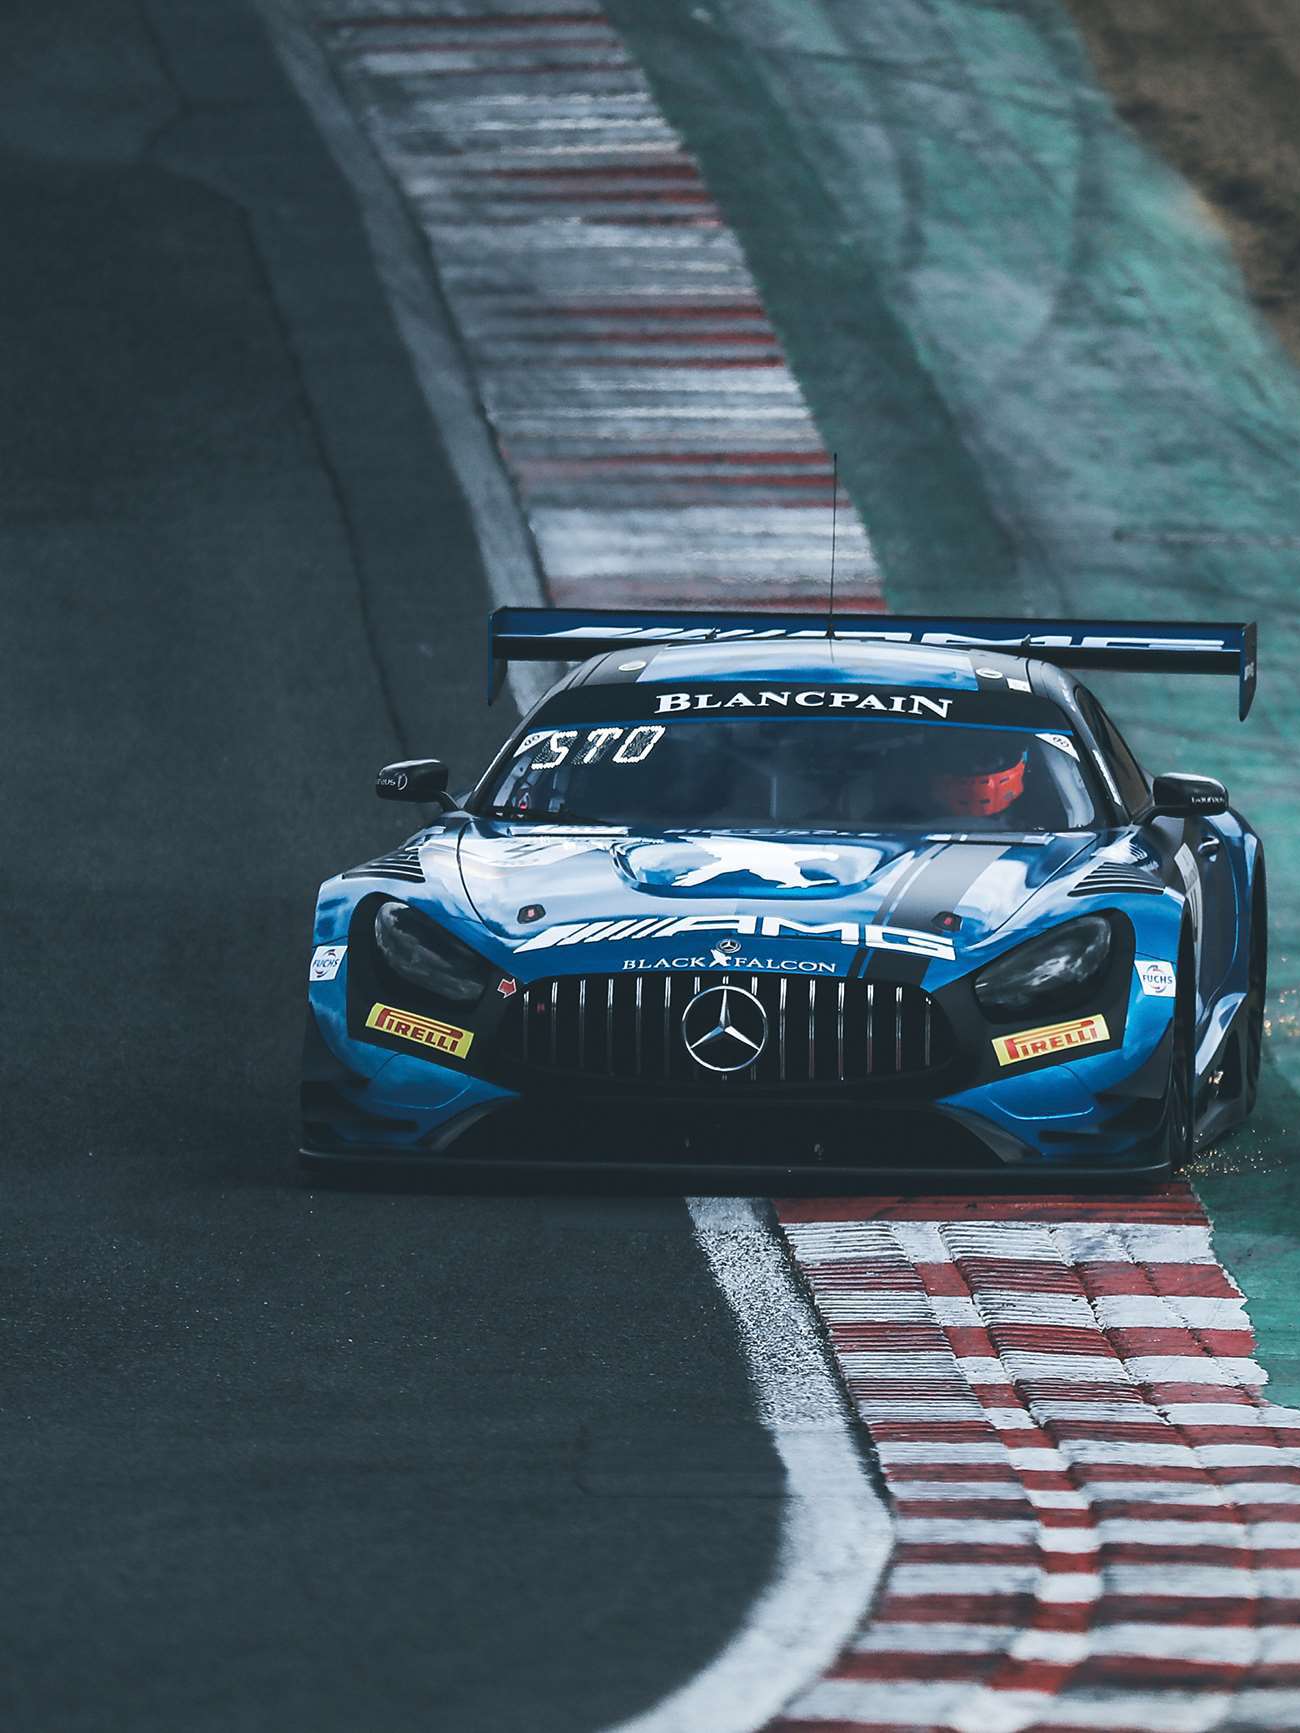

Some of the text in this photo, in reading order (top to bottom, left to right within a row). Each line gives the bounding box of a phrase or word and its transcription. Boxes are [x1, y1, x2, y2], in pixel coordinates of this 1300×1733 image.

[654, 691, 953, 719] BLANCPAIN
[656, 914, 957, 961] AMG
[312, 958, 340, 968] FUCHS
[622, 957, 836, 973] BLACK FALCON
[1142, 974, 1173, 984] FUCHS
[375, 1007, 463, 1053] PIRELLI
[1004, 1019, 1094, 1060] PIRELLI
